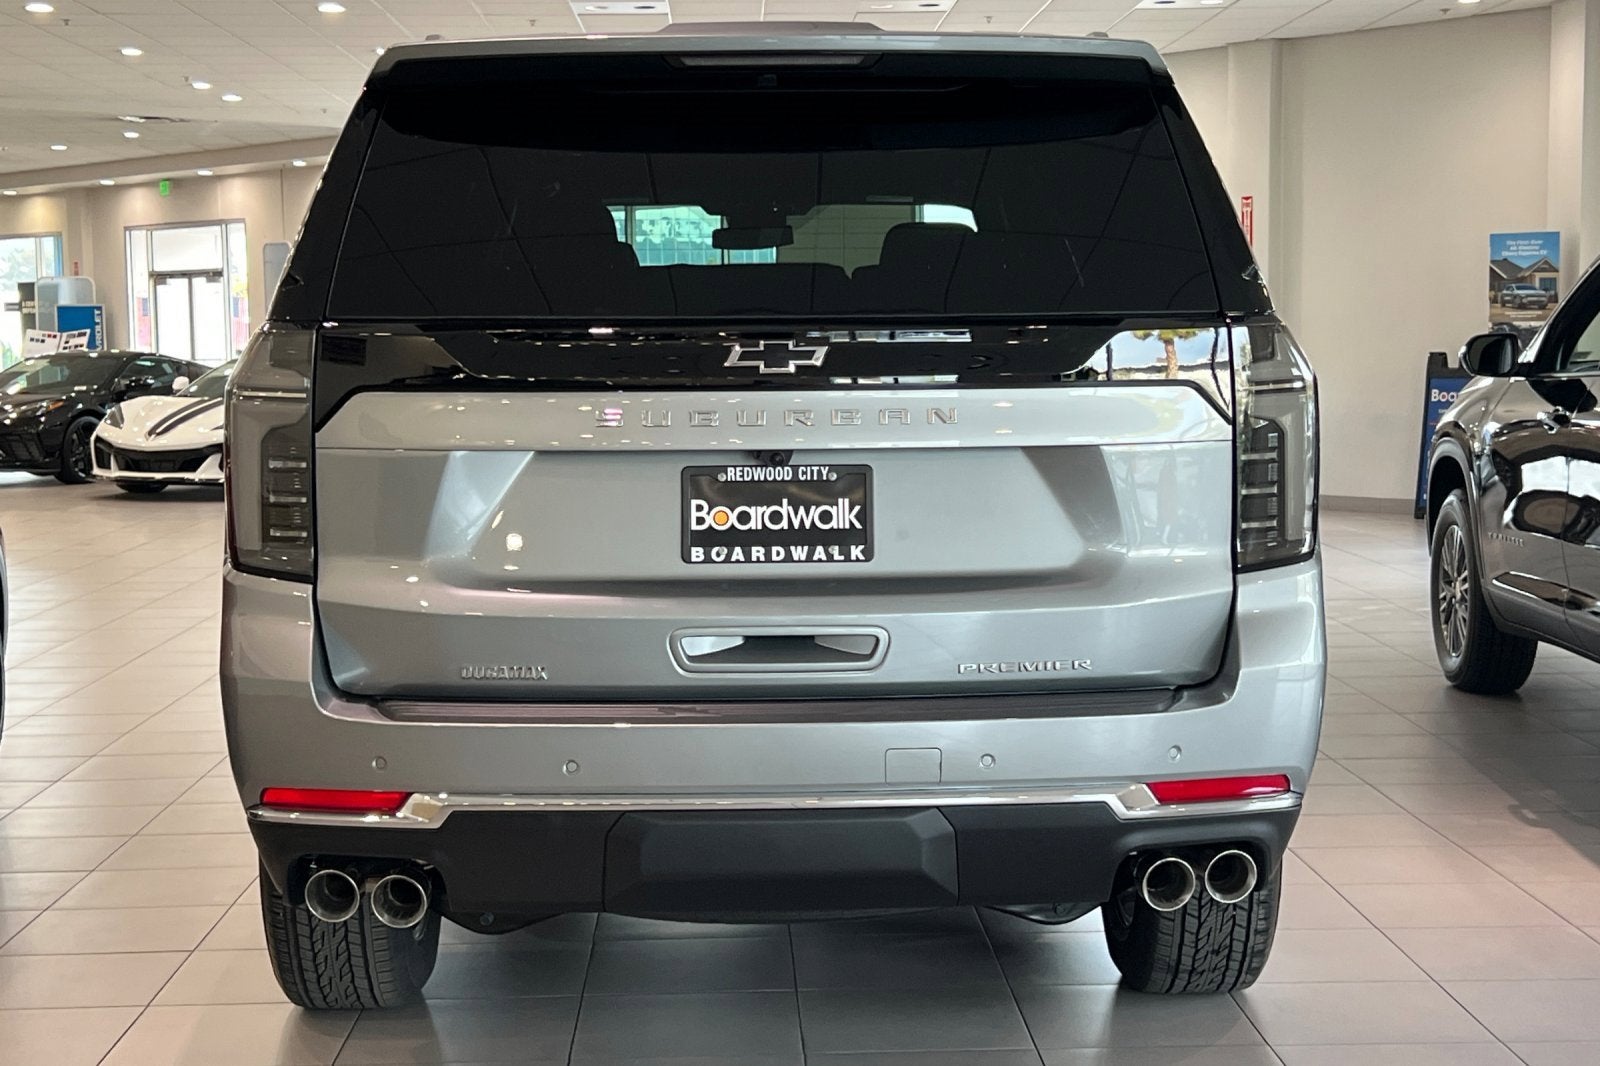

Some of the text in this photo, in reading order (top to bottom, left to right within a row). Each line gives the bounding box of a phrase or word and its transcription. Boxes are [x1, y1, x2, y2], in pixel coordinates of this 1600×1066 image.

[94, 308, 102, 350] VROLET
[595, 407, 959, 427] SUBURBAN
[727, 466, 829, 481] REDWOOD CITY
[690, 498, 863, 531] Boardwalk
[690, 545, 866, 562] BOARDWALK
[461, 665, 548, 680] DURAMAX
[958, 660, 1092, 674] PREMIER
